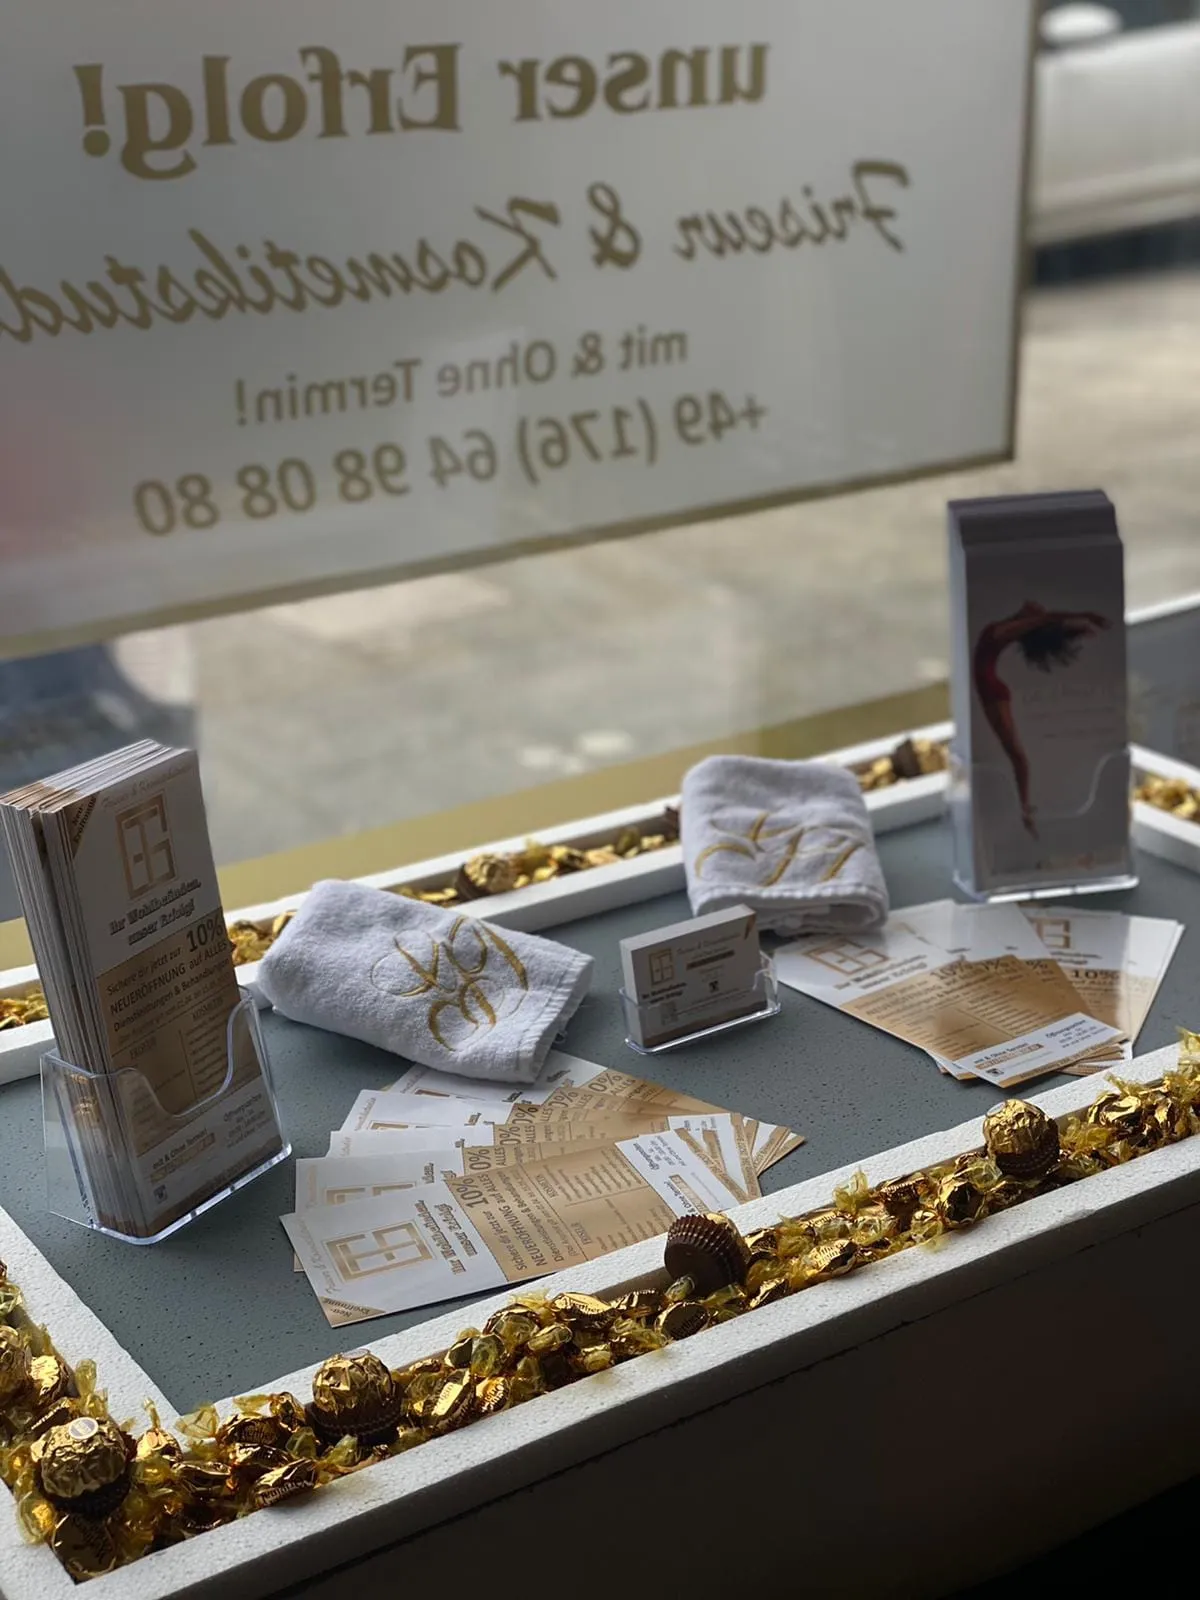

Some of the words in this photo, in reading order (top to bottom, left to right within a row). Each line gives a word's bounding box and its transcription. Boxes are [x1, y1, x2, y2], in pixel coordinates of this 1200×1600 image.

[186, 914, 223, 953] 10%
[109, 962, 187, 1016] NEUERÖFFNUNG
[204, 941, 229, 959] ALLES
[524, 1124, 536, 1143] ALLES
[495, 1146, 507, 1167] ALLES
[451, 1176, 489, 1210] 10%
[477, 1172, 498, 1194] ALLES
[495, 1169, 528, 1209] Behandlungen
[489, 1191, 506, 1205] auf
[520, 1206, 532, 1214] &
[413, 1198, 456, 1260] Wohlbefinden,
[434, 1202, 462, 1233] Erfolg!
[482, 1209, 495, 1221] zur
[489, 1219, 508, 1237] jetzt
[453, 1229, 478, 1258] unser
[498, 1204, 548, 1267] NEUERÖFFNUNG
[498, 1233, 512, 1245] dir
[526, 1211, 565, 1263] Dienstleistungen
[447, 1257, 467, 1275] Ihr
[505, 1243, 528, 1272] Sichere
